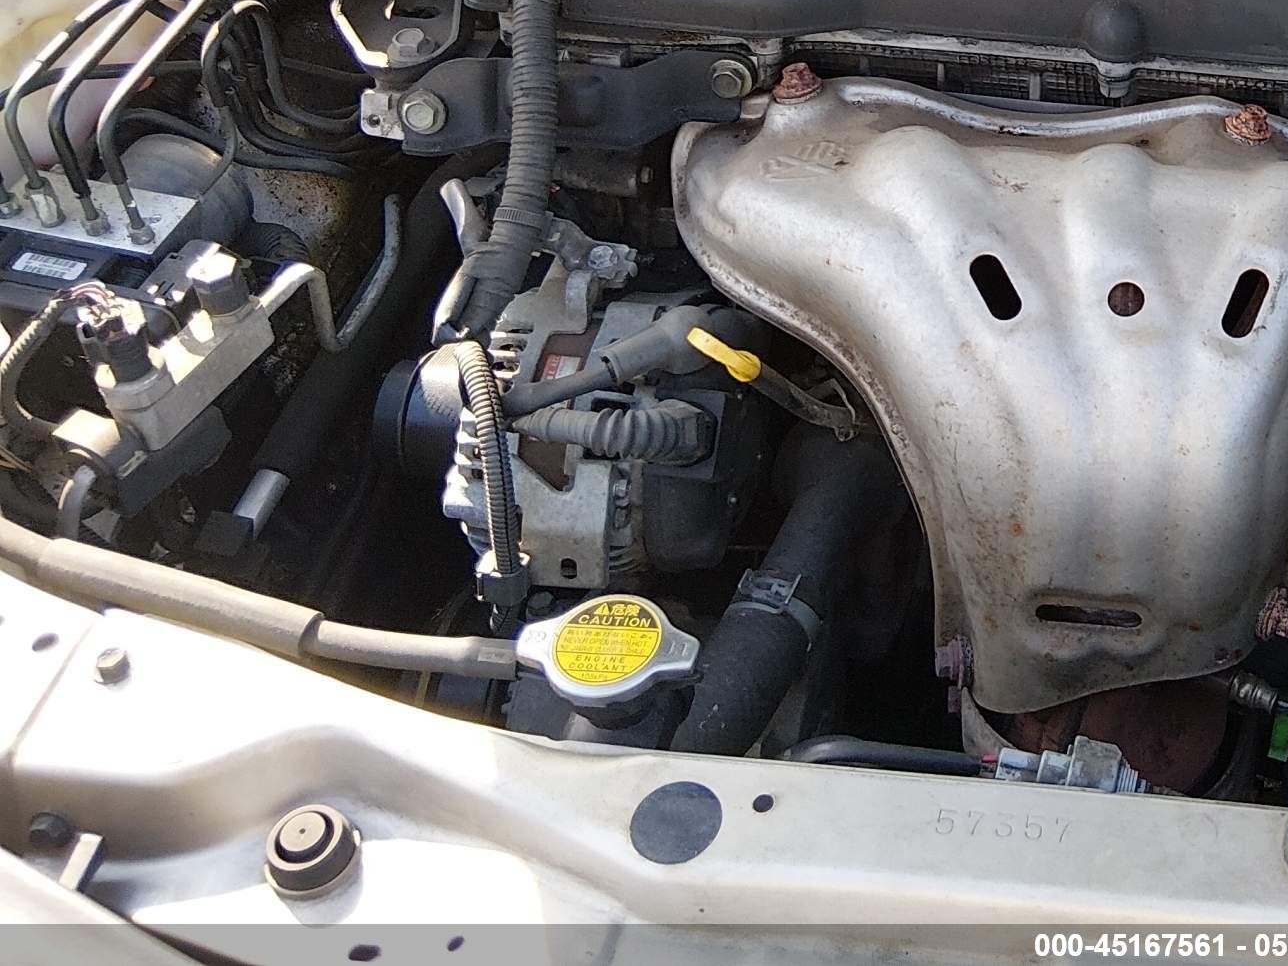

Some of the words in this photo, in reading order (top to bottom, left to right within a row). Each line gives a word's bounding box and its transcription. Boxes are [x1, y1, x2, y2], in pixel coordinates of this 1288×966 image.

[577, 614, 653, 628] CAUTION
[575, 655, 626, 664] ENGINE
[568, 662, 628, 671] COOLANT
[935, 808, 1074, 843] 57357
